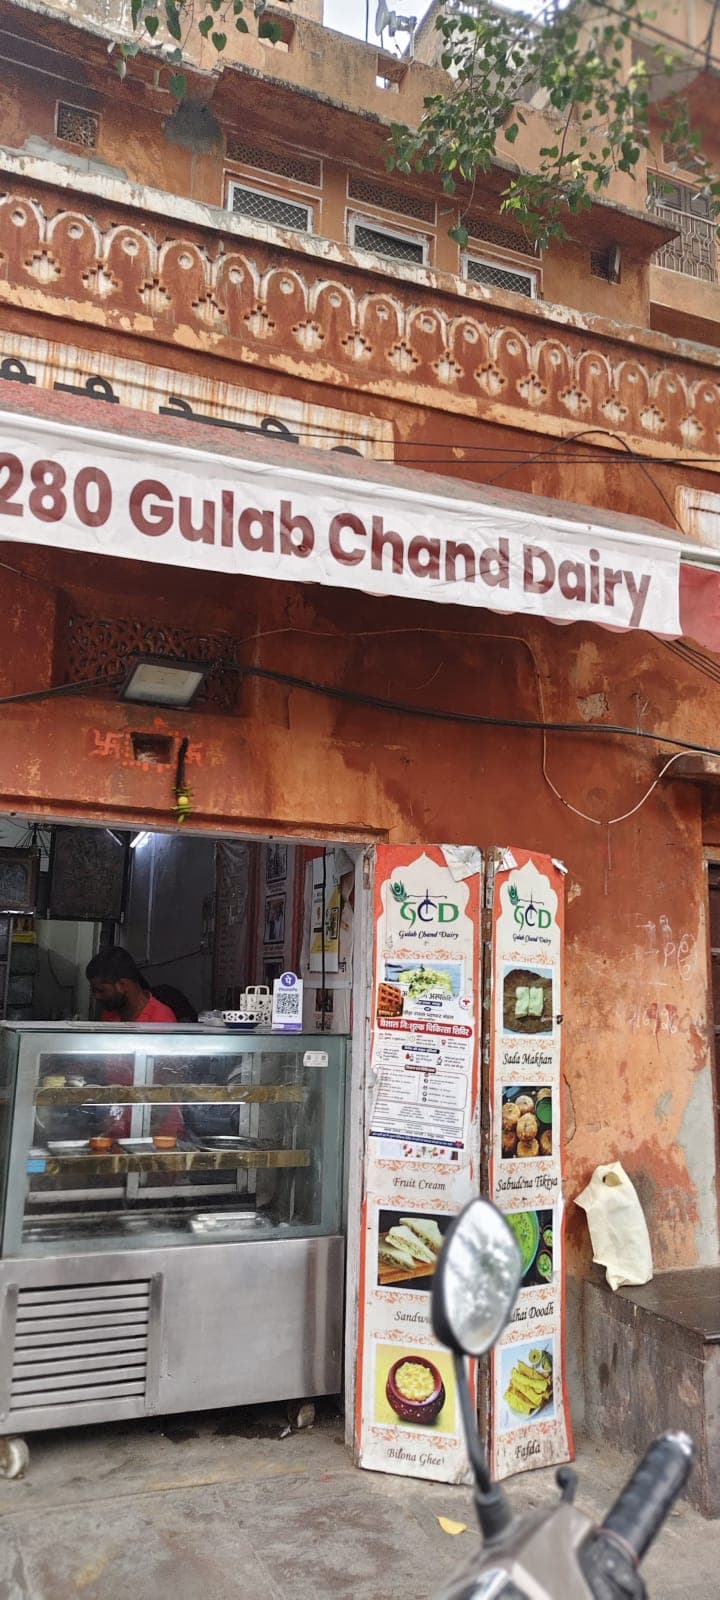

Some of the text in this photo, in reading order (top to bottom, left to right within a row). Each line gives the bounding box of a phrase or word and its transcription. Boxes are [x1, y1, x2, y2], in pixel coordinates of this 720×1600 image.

[129, 479, 314, 557] Gulab
[328, 513, 509, 588] Chand
[523, 545, 651, 627] Dairy
[398, 930, 459, 940] Gulab Chand Dairy
[513, 933, 552, 945] Gulab Chand Dairy
[503, 1052, 553, 1067] Sada Makhan
[393, 1177, 446, 1191] Fruit Cream
[394, 1311, 431, 1324] Sandw
[528, 1302, 554, 1319] Doodh
[387, 1448, 441, 1466] Bilona Ghee
[515, 1439, 541, 1461] Fafda
